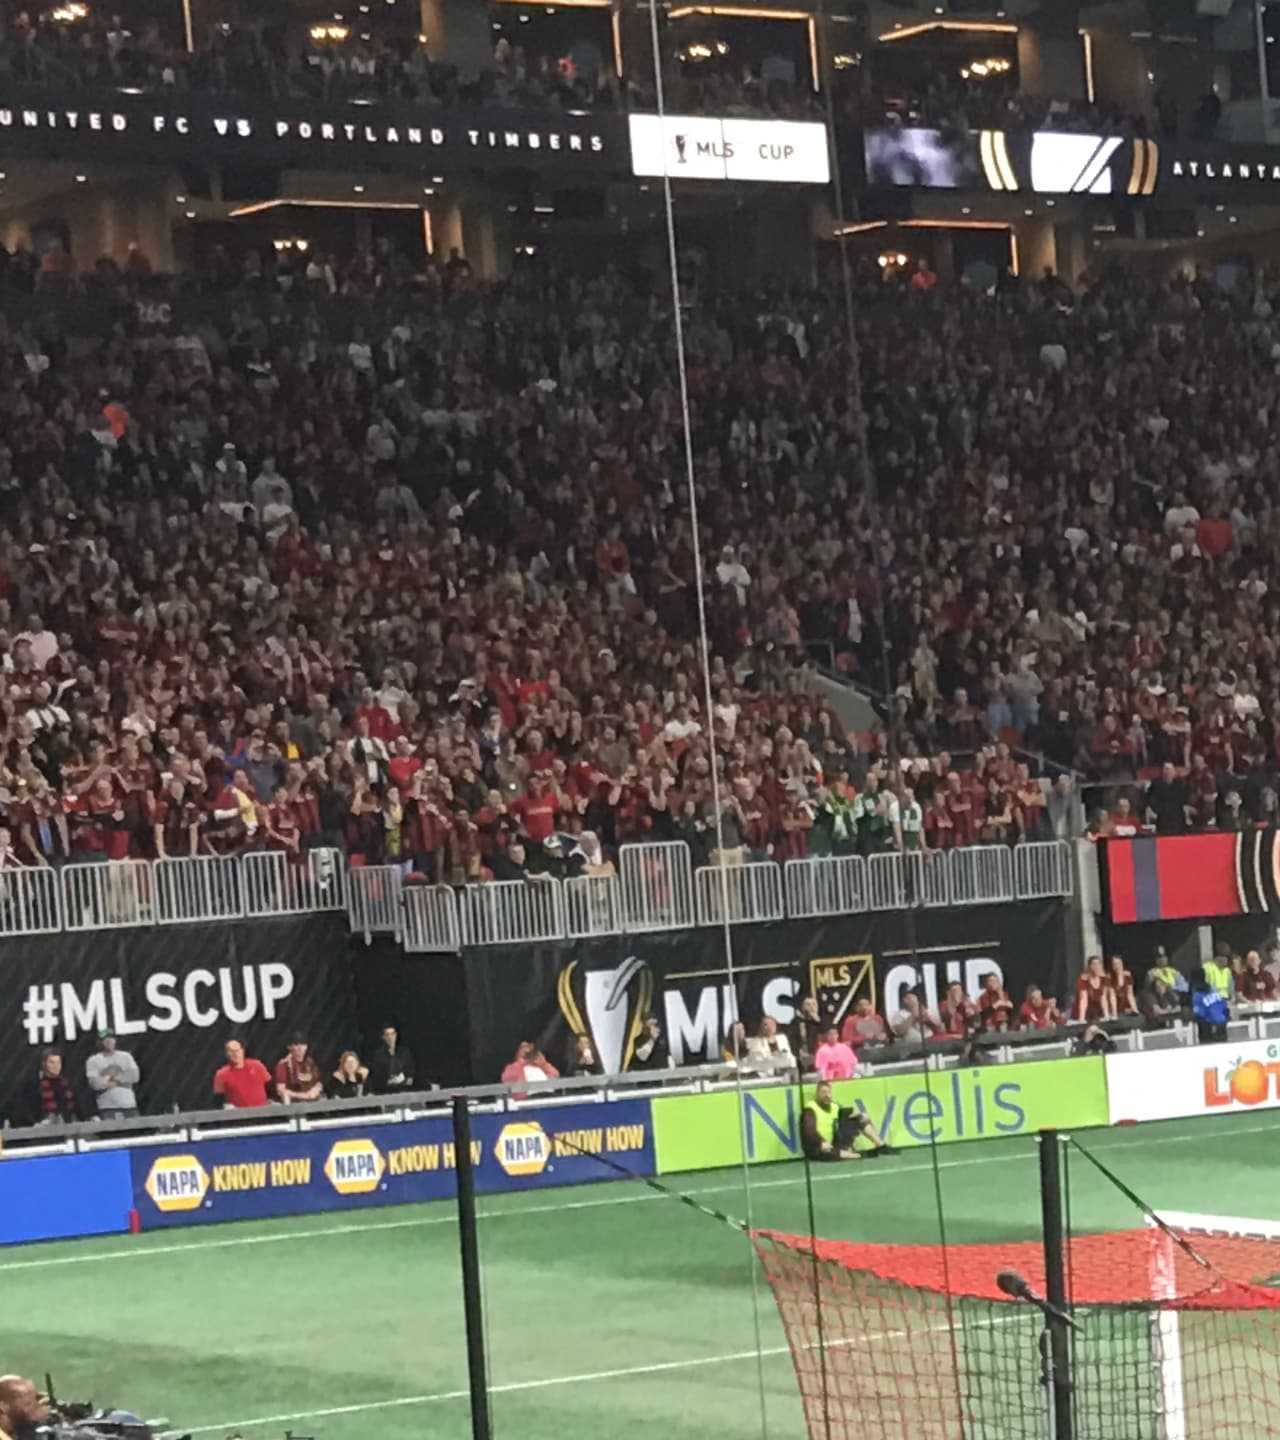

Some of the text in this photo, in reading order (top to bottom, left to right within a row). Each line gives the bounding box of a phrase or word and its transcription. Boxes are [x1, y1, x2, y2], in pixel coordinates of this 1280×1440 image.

[0, 109, 602, 151] UNITED FC VS PORTLAND TIMBERS
[696, 141, 794, 160] MLS CUP
[816, 965, 851, 988] MLS
[23, 962, 294, 1045] #MLSCUP
[743, 1070, 1026, 1158] Nvelis
[505, 1136, 544, 1161] NAPA
[555, 1125, 645, 1157] KNOW HOW
[336, 1151, 377, 1180] NAPA
[389, 1140, 482, 1176] KNOW HW
[156, 1168, 201, 1197] NAPA
[213, 1157, 311, 1192] KNOW HOW
